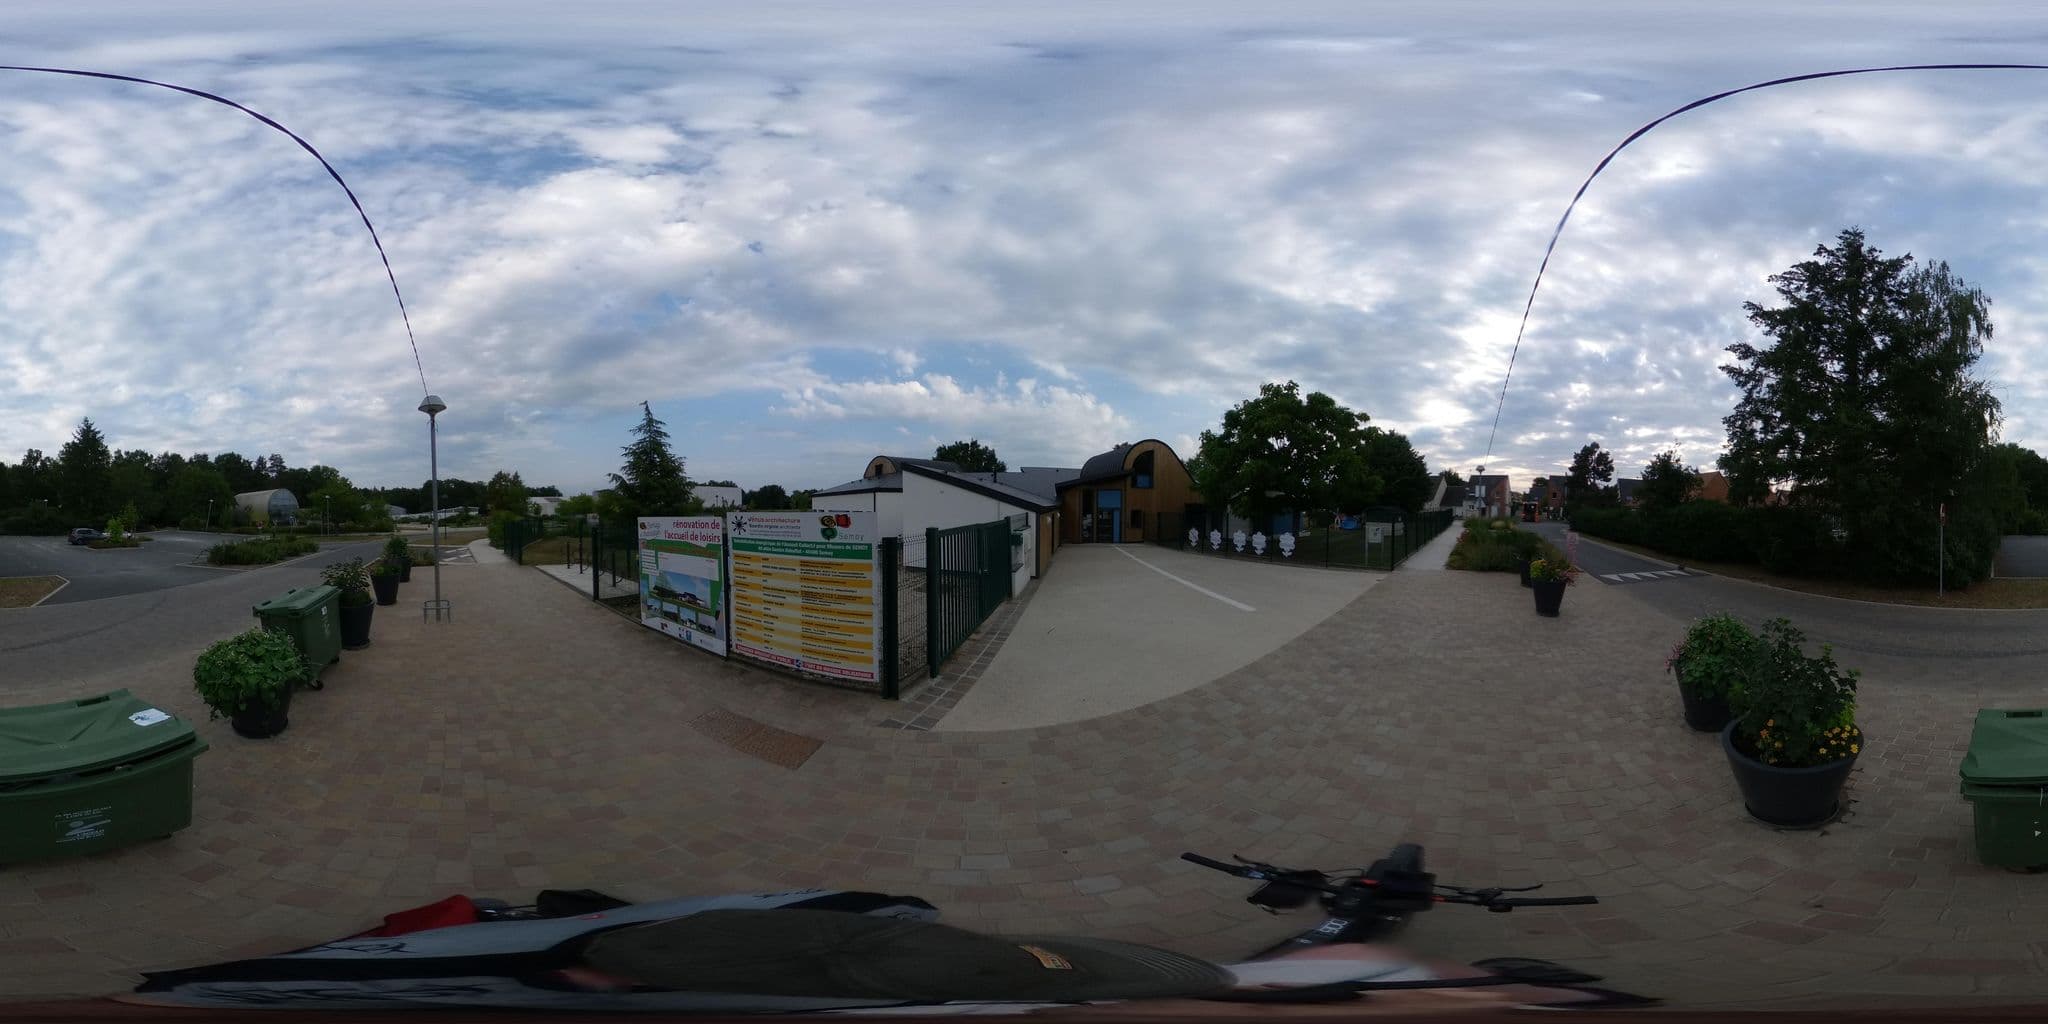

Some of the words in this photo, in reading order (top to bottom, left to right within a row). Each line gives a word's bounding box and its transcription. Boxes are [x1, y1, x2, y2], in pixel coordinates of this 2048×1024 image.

[672, 519, 709, 529] rénovation
[710, 519, 720, 529] de
[664, 530, 689, 540] l'accueil
[690, 531, 698, 541] de
[699, 532, 721, 542] loisirs
